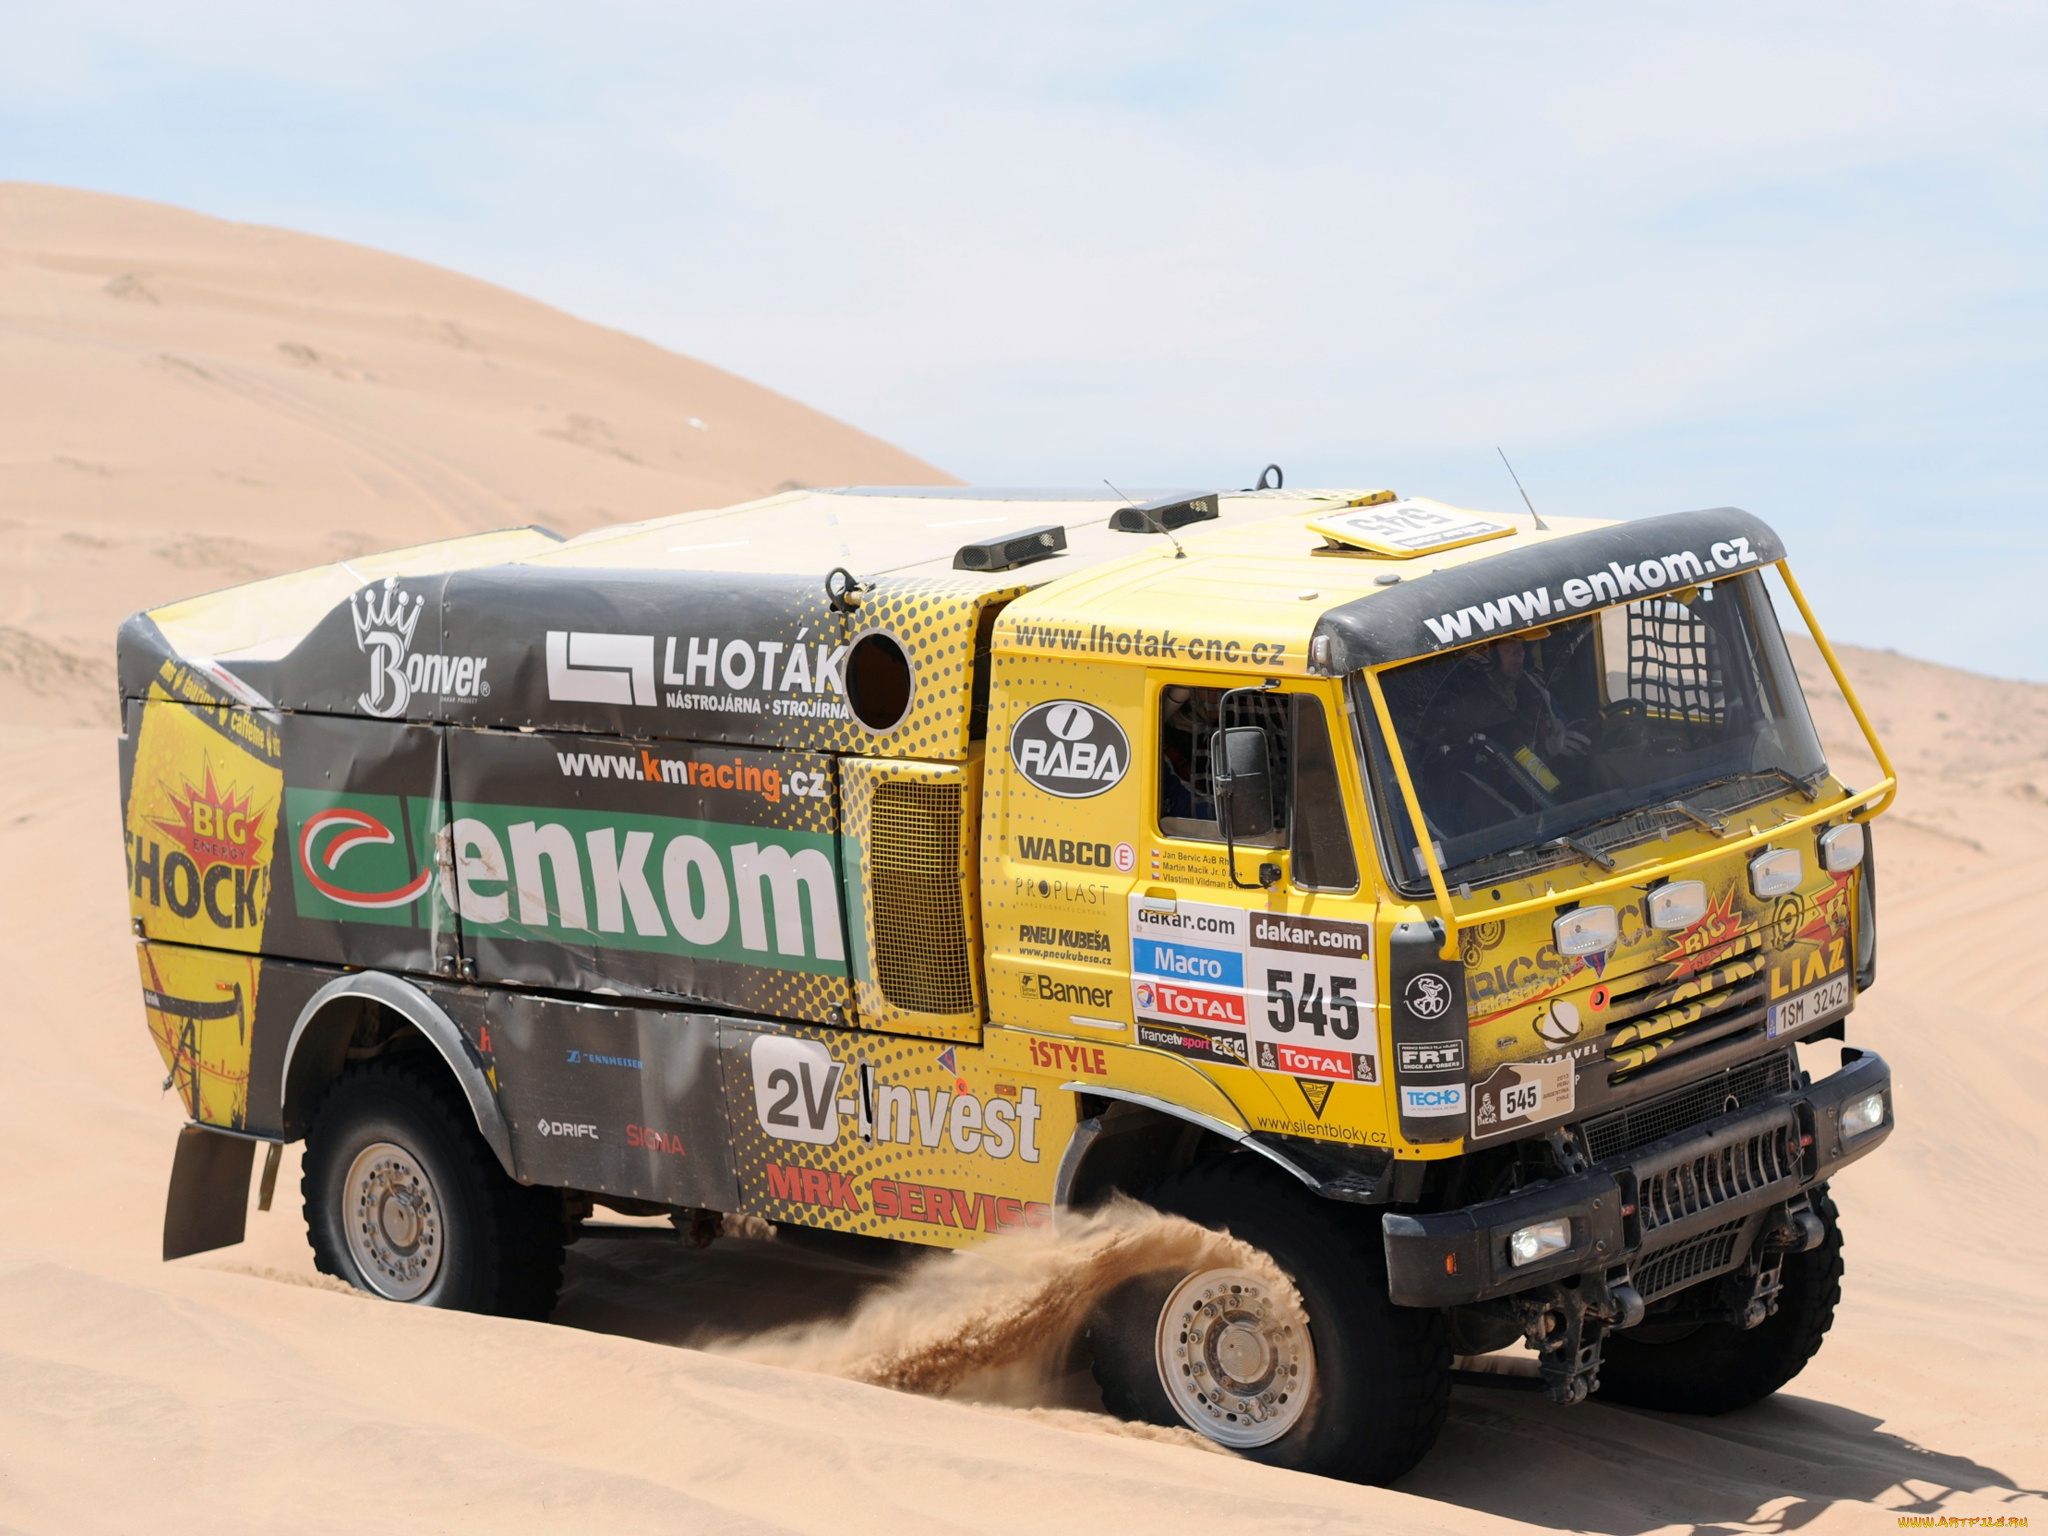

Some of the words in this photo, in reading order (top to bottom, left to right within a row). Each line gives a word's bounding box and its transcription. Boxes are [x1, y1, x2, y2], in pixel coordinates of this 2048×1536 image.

[1423, 537, 1758, 646] www.enkom.cz
[1016, 624, 1286, 666] www.lhotak-cnc.cz
[357, 631, 488, 718] Bonver
[663, 628, 849, 695] LHOTÁK
[666, 691, 762, 715] NÁSTROJÁRNA
[772, 698, 850, 720] STROJÍRNA
[231, 712, 265, 750] caffeine
[556, 751, 826, 802] www.kmracing.cz
[193, 800, 247, 845] BIG
[193, 838, 247, 861] ENERGY
[1018, 835, 1111, 868] WABCO
[1163, 851, 1176, 860] Jan
[1163, 862, 1186, 873] Martin
[1163, 874, 1194, 884] Vlastimil
[435, 817, 845, 961] enkom
[1019, 925, 1056, 945] PNEU
[1058, 929, 1111, 952] KUBEŠA
[1255, 919, 1362, 950] dakar.com
[1685, 912, 1726, 961] BIG
[1019, 947, 1112, 965] www.pneukubesa.cz
[1155, 947, 1222, 978] Macro
[1038, 974, 1113, 1008] Banner
[1158, 988, 1242, 1021] TOTAL
[1266, 969, 1359, 1040] 545
[1781, 999, 1804, 1029] 1SM
[1814, 982, 1843, 1015] 3242
[583, 1053, 643, 1070] ENNHEISER
[1280, 1048, 1351, 1074] TOTAL
[1402, 1049, 1459, 1064] FRT
[1531, 1044, 1599, 1064] TRAVEL
[1506, 1086, 1537, 1114] 545
[1543, 1087, 1569, 1099] ARGENTINA
[1257, 1117, 1387, 1144] www.silentbloky.cz
[766, 1163, 863, 1213] MRK
